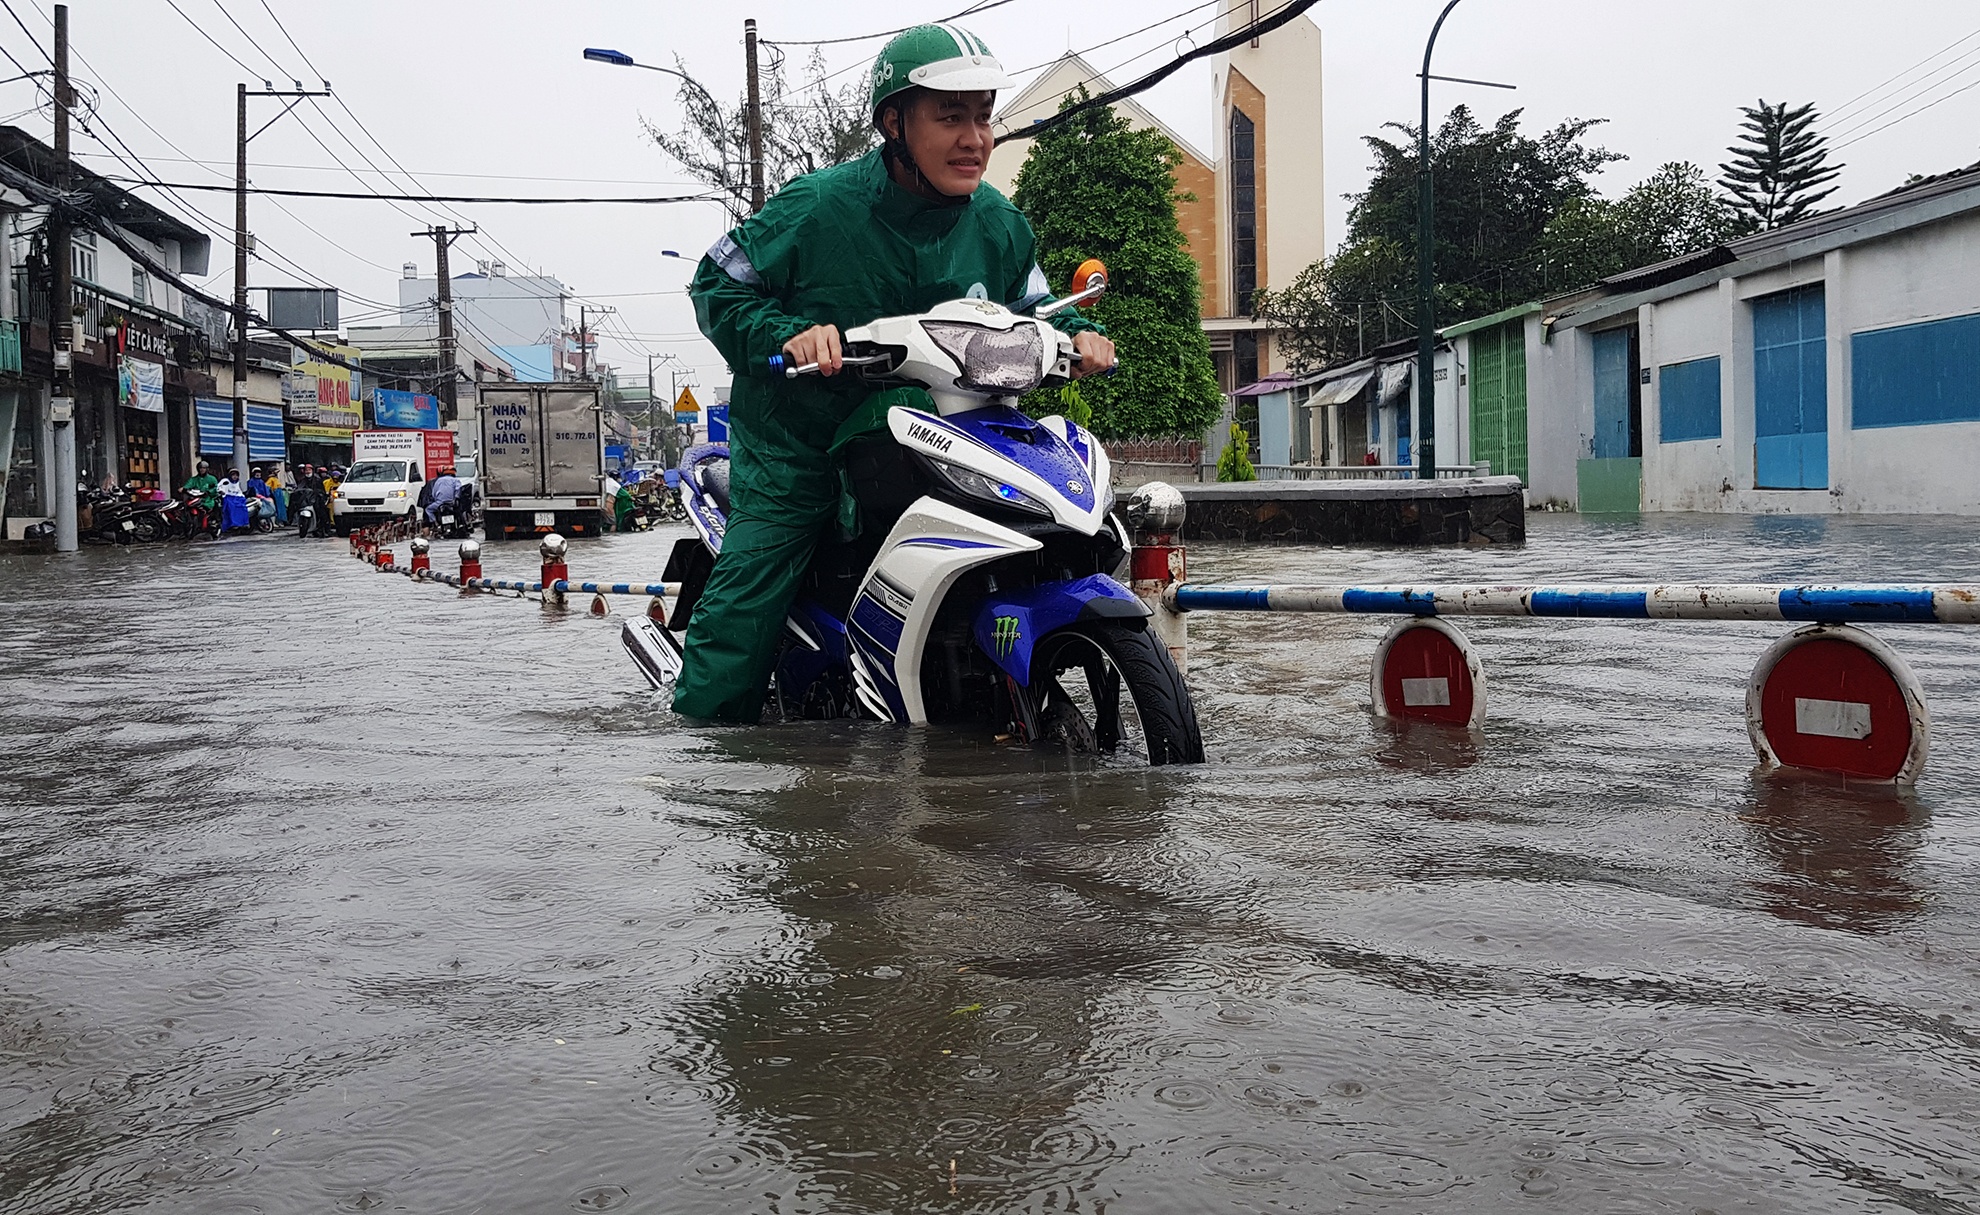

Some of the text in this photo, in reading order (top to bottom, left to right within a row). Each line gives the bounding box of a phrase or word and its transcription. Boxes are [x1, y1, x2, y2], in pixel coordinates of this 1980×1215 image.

[141, 327, 152, 352] CÀ
[152, 334, 167, 356] PHÊ
[318, 371, 335, 407] ÀNG
[336, 379, 351, 408] GIA
[492, 403, 527, 417] NHẬN
[495, 415, 522, 431] CHỞ
[492, 431, 527, 444] HÀNG
[907, 422, 953, 453] YAMAHA
